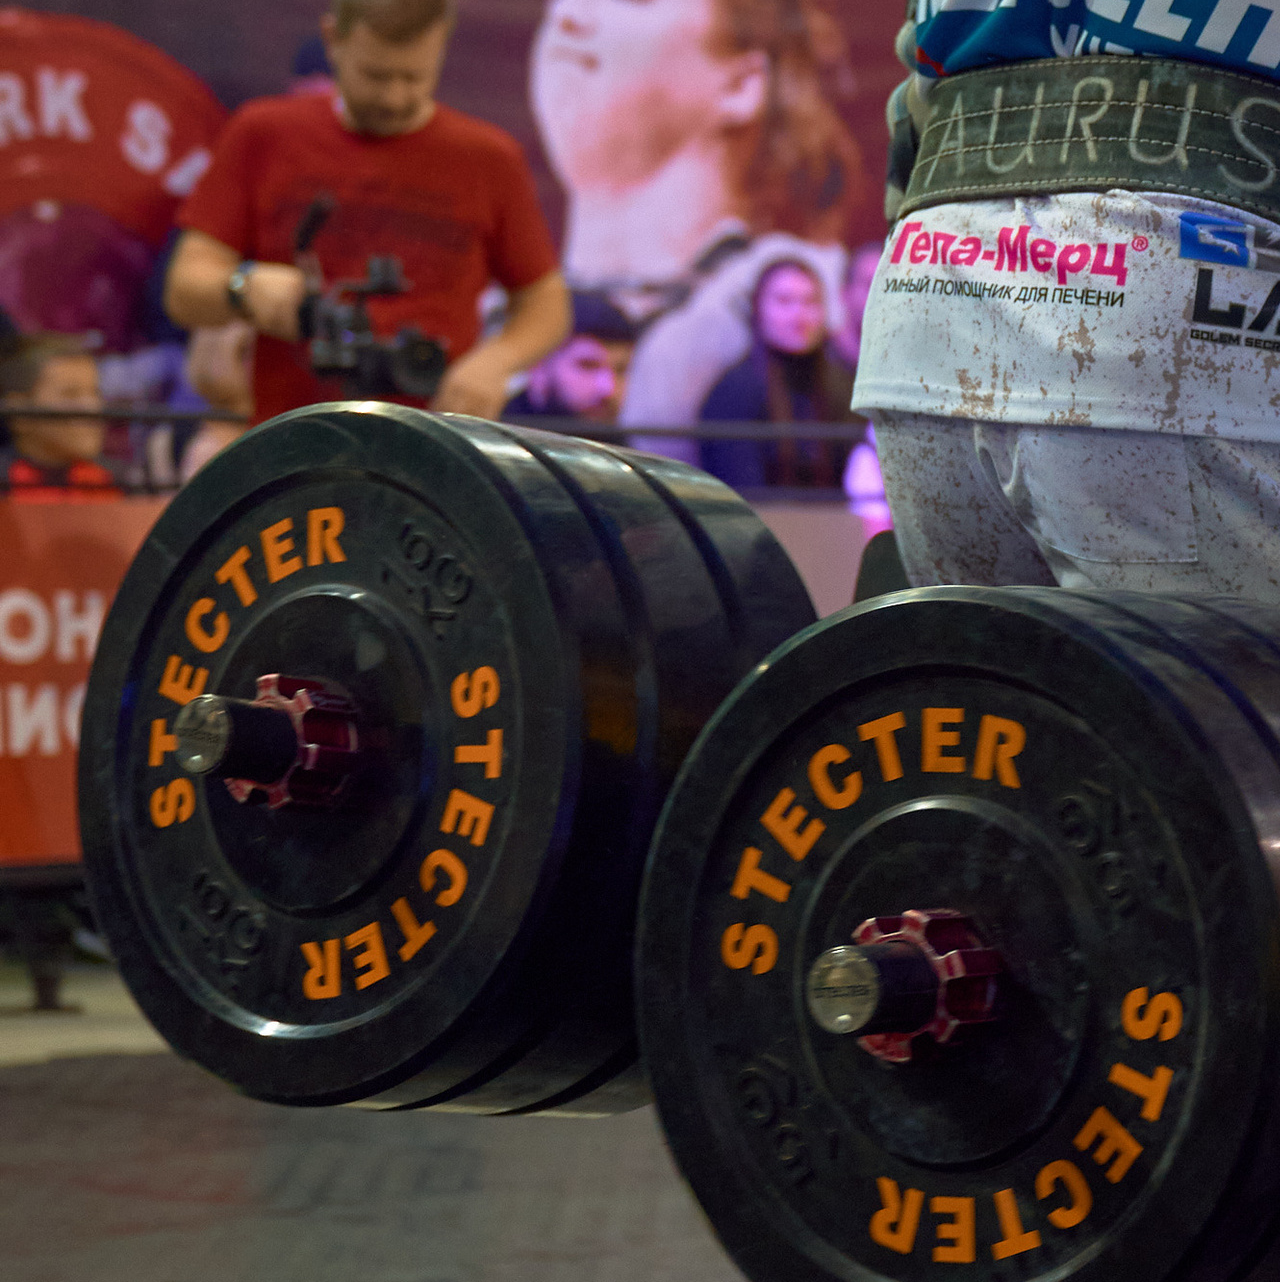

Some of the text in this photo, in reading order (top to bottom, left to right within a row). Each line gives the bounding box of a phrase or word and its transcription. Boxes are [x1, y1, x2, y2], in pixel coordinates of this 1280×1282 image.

[884, 276, 1125, 308] УМНЫЙ ПОМОЩНИК ДЛЯ ПЕЧЕНИ
[1190, 329, 1241, 346] GOLEM
[149, 506, 347, 830] STECTER
[300, 666, 504, 1000] STECTER
[721, 707, 1028, 975] STECTER
[869, 986, 1184, 1264] STECTER
